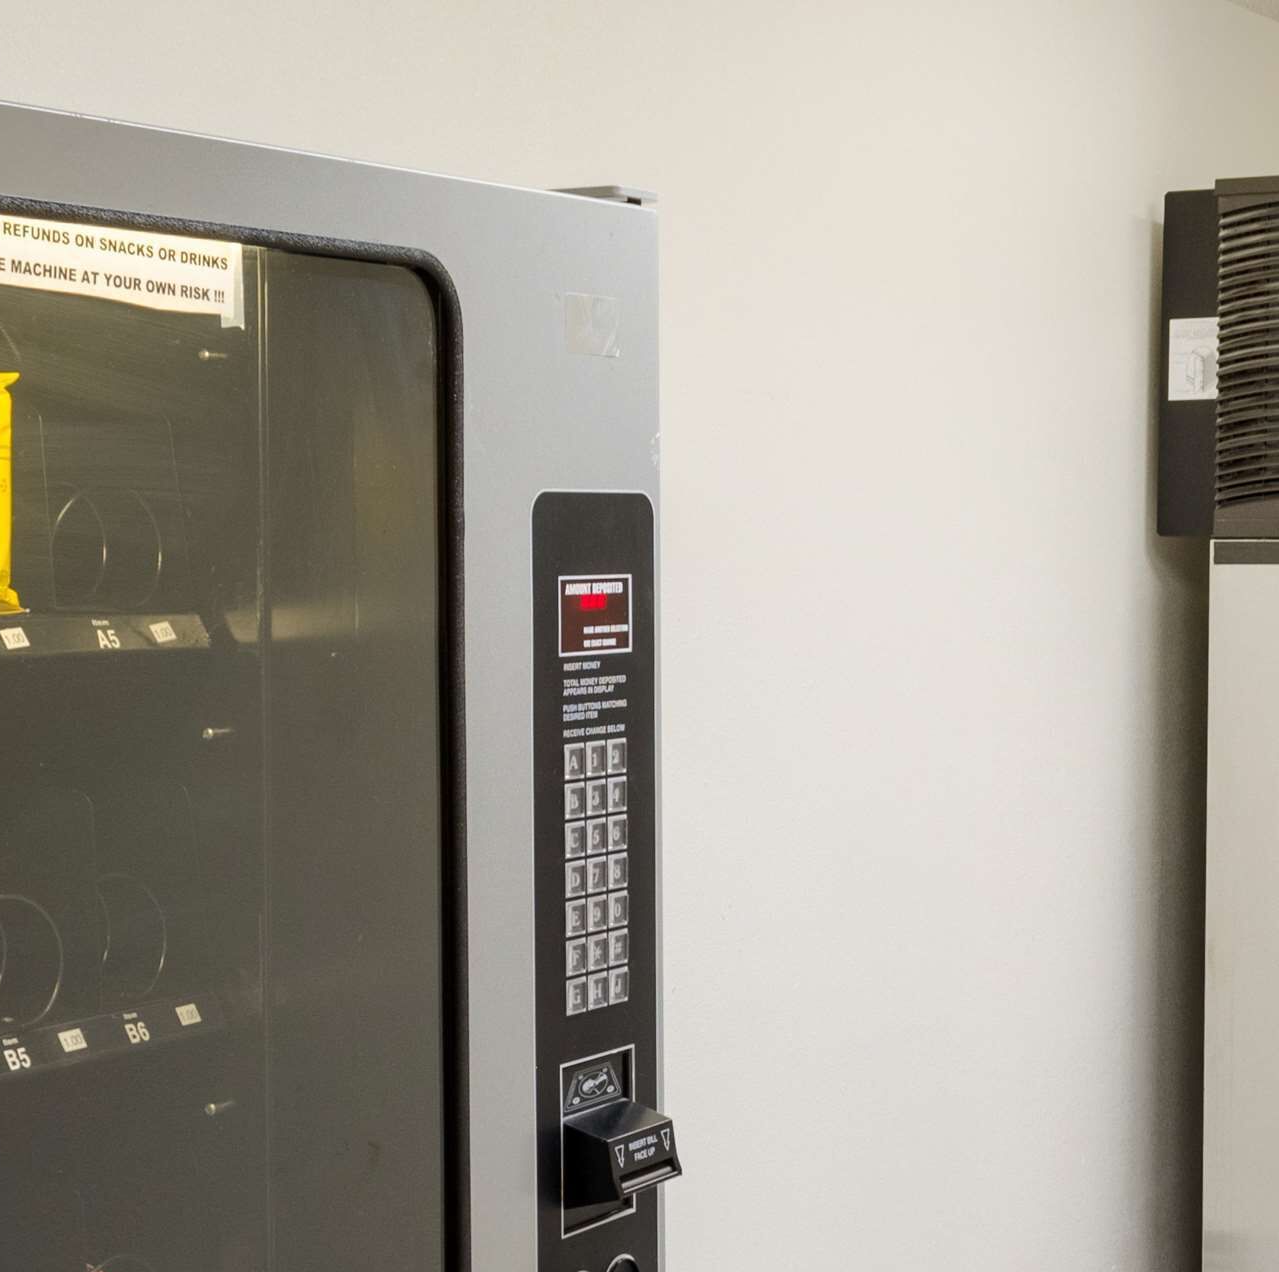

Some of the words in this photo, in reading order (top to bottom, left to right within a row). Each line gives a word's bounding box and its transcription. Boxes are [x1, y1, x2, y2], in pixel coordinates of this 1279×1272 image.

[3, 219, 70, 245] REFUNDS
[75, 234, 94, 249] ON
[99, 238, 154, 258] SNACKS
[158, 247, 176, 262] OR
[180, 251, 229, 270] DRINKS
[11, 259, 77, 282] MACHINE
[81, 270, 100, 285] AT
[103, 273, 142, 291] YOUR
[145, 280, 176, 296] OWN
[180, 285, 211, 301] RISK
[214, 290, 225, 303] !!!
[96, 629, 121, 649] A5
[569, 755, 578, 770] A
[592, 753, 597, 767] 1
[612, 749, 619, 764] 2
[592, 791, 600, 806] 3
[592, 829, 600, 845] 5
[613, 826, 620, 841] 6
[592, 868, 600, 883] 7
[614, 865, 621, 879] 8
[572, 873, 580, 887] D
[572, 911, 580, 926] E
[593, 907, 600, 922] 9
[593, 983, 602, 999] H
[125, 1022, 150, 1044] B6
[3, 1047, 32, 1071] B5
[648, 1146, 655, 1157] UP
